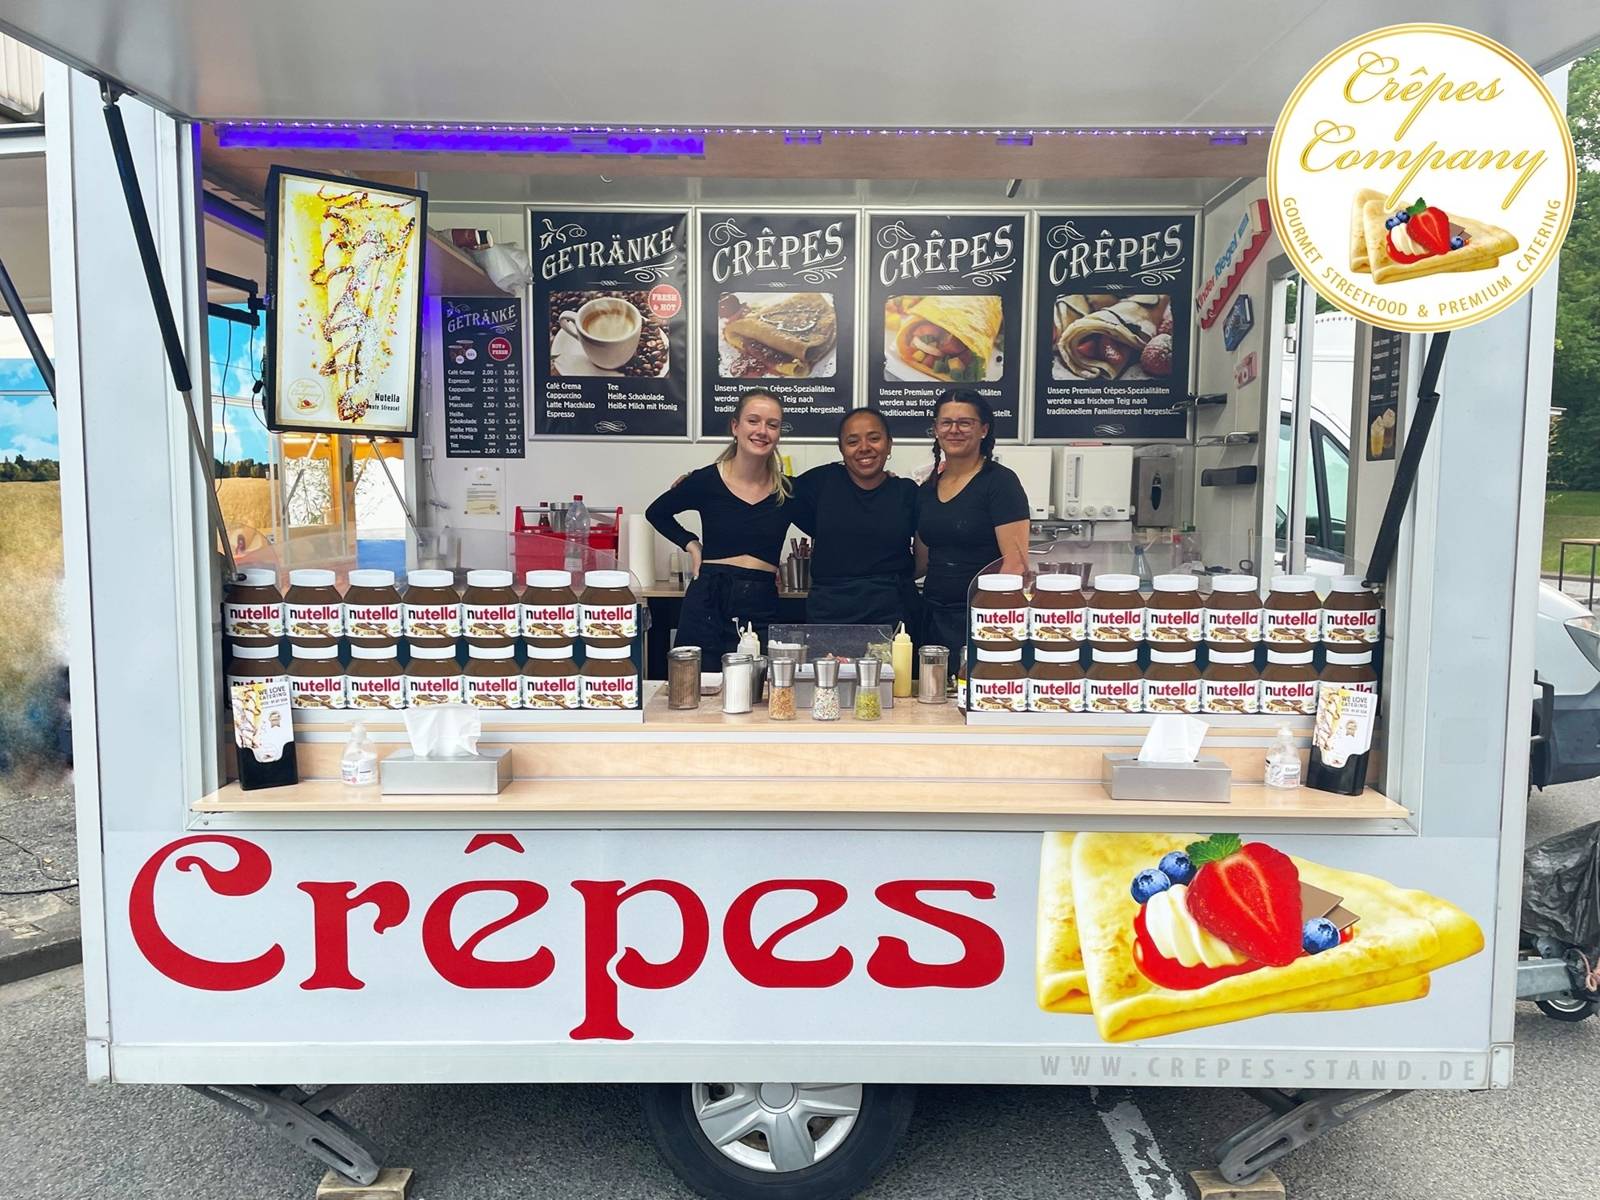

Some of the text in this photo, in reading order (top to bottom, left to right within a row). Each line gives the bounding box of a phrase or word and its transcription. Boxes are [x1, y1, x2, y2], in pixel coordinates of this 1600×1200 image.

[542, 226, 676, 280] GETRÄNKE
[712, 220, 843, 284] CRÊPES
[879, 223, 1013, 287] CRÊPES
[1049, 223, 1183, 286] CRÊPES
[652, 293, 677, 301] FRESH
[660, 303, 676, 311] HOT
[447, 304, 516, 333] GETRÄNKE
[546, 391, 582, 399] Cappuccino
[770, 384, 836, 393] Crêpes-Spezialitäten
[1103, 386, 1170, 395] Crêpes-Spezialitäten
[628, 392, 665, 401] Schokolade
[628, 402, 645, 410] Milch
[658, 403, 678, 411] Honig
[810, 405, 846, 414] hergestellt.
[1094, 408, 1142, 416] Familienrezept
[230, 606, 280, 620] nutella
[290, 606, 339, 620] nutella
[350, 606, 398, 620] nutella
[408, 606, 456, 620] nutella
[467, 607, 516, 620] nutella
[526, 607, 574, 620] nutella
[584, 607, 632, 620] nutella
[977, 610, 1024, 624] nutella
[1034, 611, 1082, 624] nutella
[1093, 611, 1140, 624] nutella
[1151, 611, 1199, 624] nutella
[1210, 612, 1258, 626] nutella
[1268, 612, 1317, 626] nutella
[1327, 612, 1376, 626] nutella
[292, 678, 342, 692] nutella
[352, 678, 400, 692] nutella
[410, 679, 458, 692] nutella
[469, 678, 517, 692] nutella
[528, 678, 575, 692] nutella
[586, 678, 633, 691] nutella
[976, 682, 1023, 695] nutella
[1033, 682, 1081, 695] nutella
[1091, 682, 1138, 695] nutella
[1149, 683, 1197, 695] nutella
[1207, 683, 1255, 696] nutella
[1266, 684, 1314, 697] nutella
[128, 833, 1006, 1041] Crêpes
[1040, 1055, 1476, 1082] WWW.CREPES-STAND.DE
